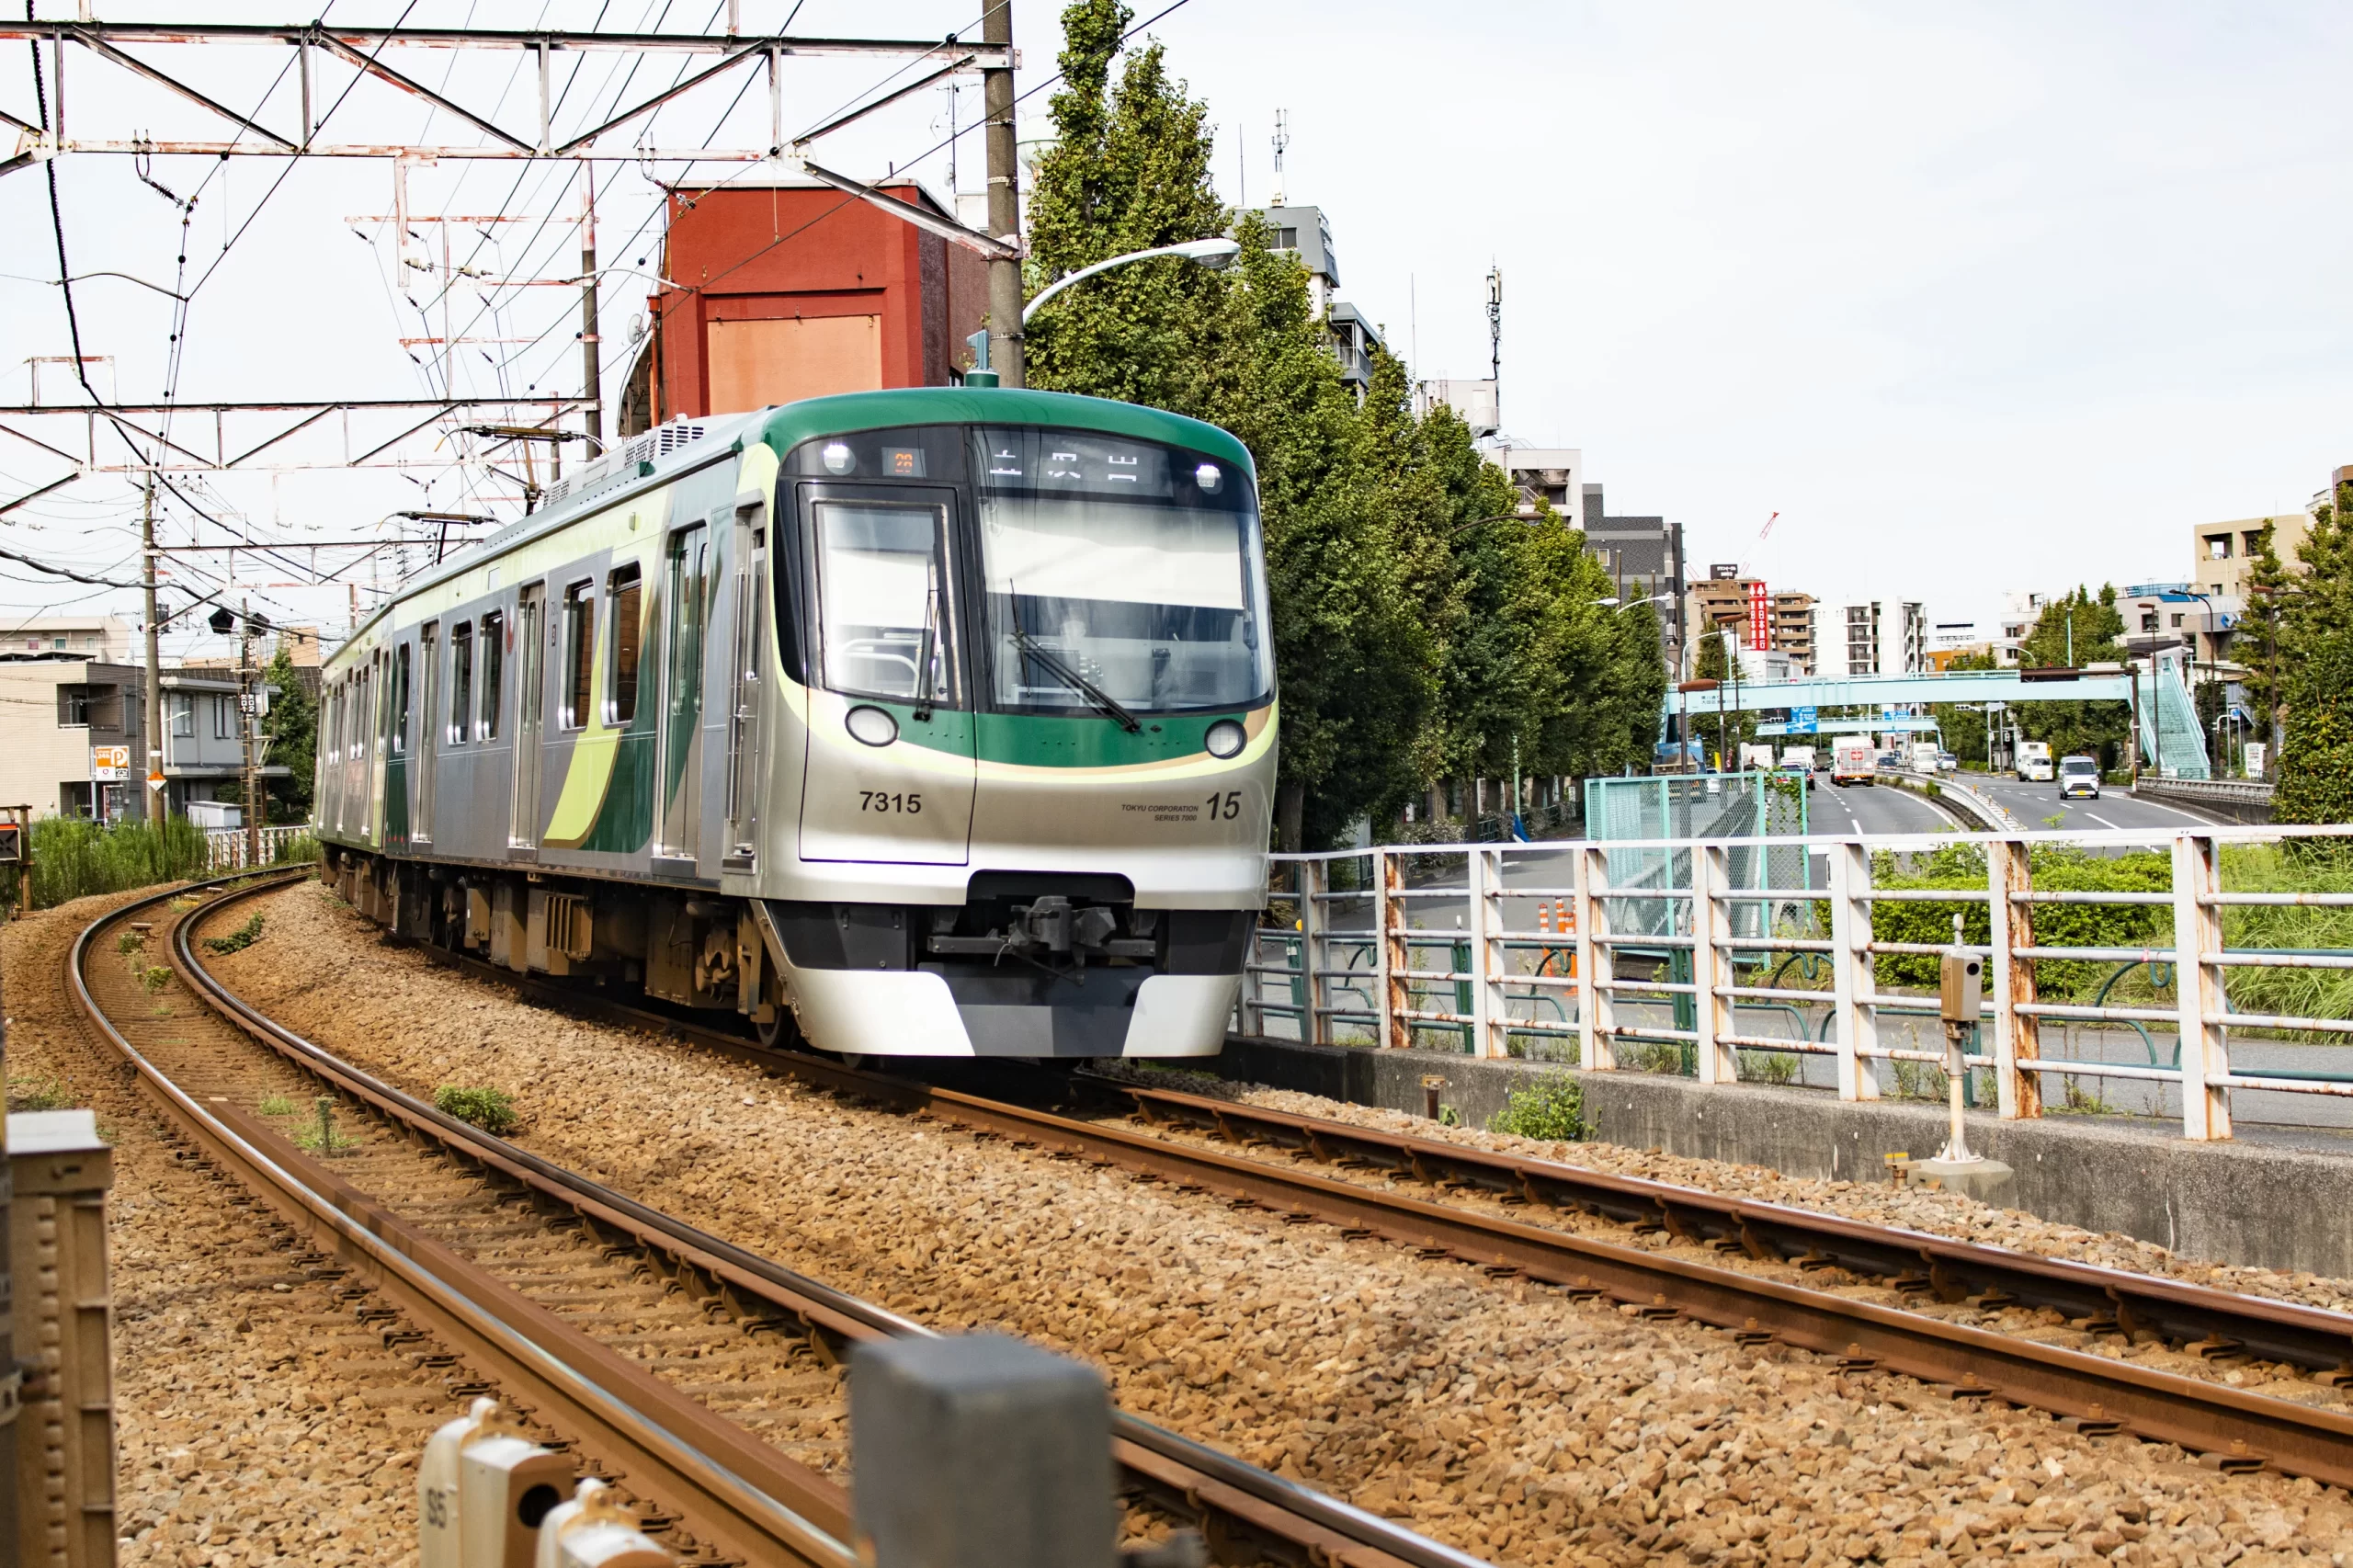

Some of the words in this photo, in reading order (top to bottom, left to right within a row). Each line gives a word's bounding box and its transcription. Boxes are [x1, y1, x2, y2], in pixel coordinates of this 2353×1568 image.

[110, 748, 128, 767] P
[116, 767, 129, 779] 空
[859, 791, 922, 814] 7315
[1206, 790, 1242, 821] 15
